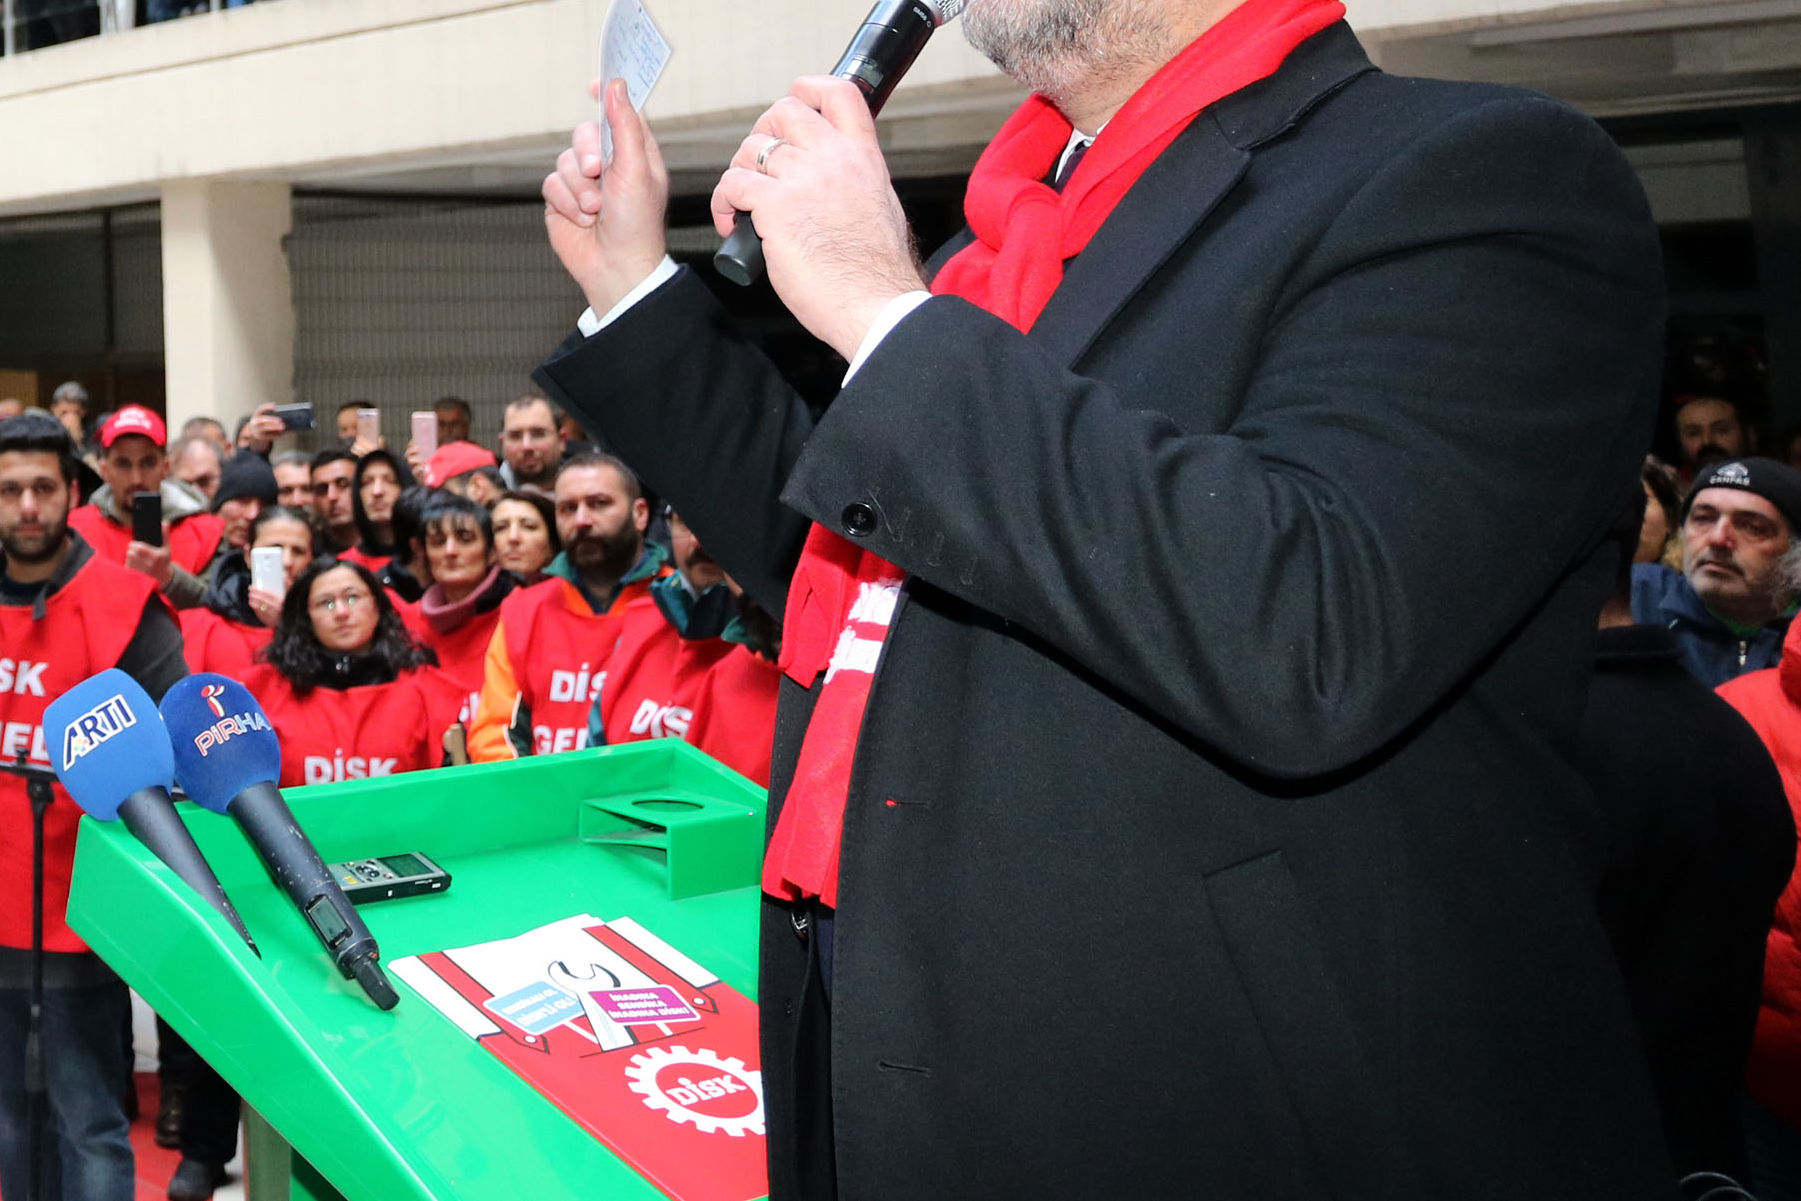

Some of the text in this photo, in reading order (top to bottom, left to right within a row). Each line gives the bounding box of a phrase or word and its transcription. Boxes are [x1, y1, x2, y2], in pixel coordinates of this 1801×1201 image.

[549, 661, 608, 703] DİS
[63, 693, 138, 773] ARTI
[628, 697, 694, 742] DİS
[303, 747, 399, 786] DİSK
[664, 1074, 748, 1106] DİSK
